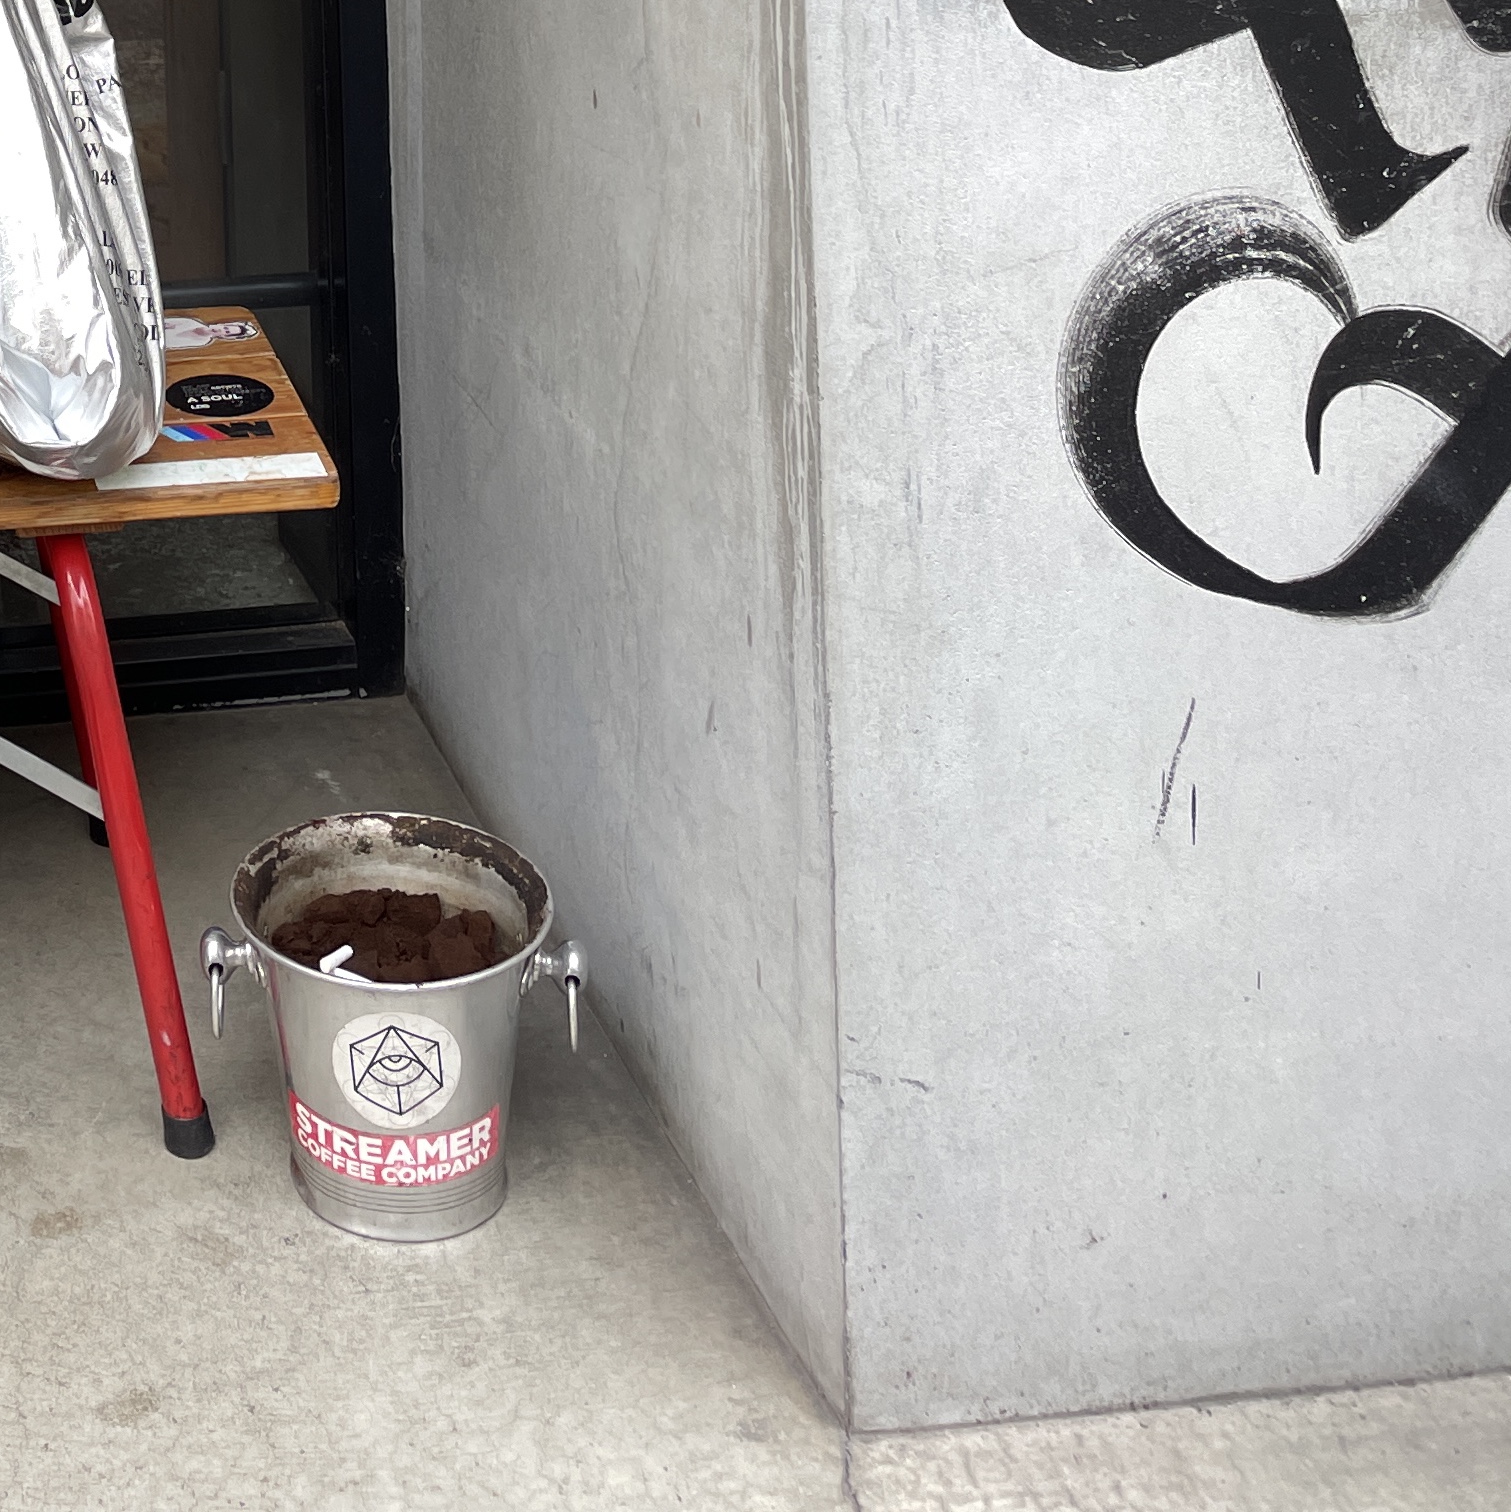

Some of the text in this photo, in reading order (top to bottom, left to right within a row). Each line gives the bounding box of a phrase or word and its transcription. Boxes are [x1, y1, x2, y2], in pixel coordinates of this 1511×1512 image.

[295, 1102, 494, 1167] STREAMER
[298, 1131, 492, 1186] COFFEE COMPANY
